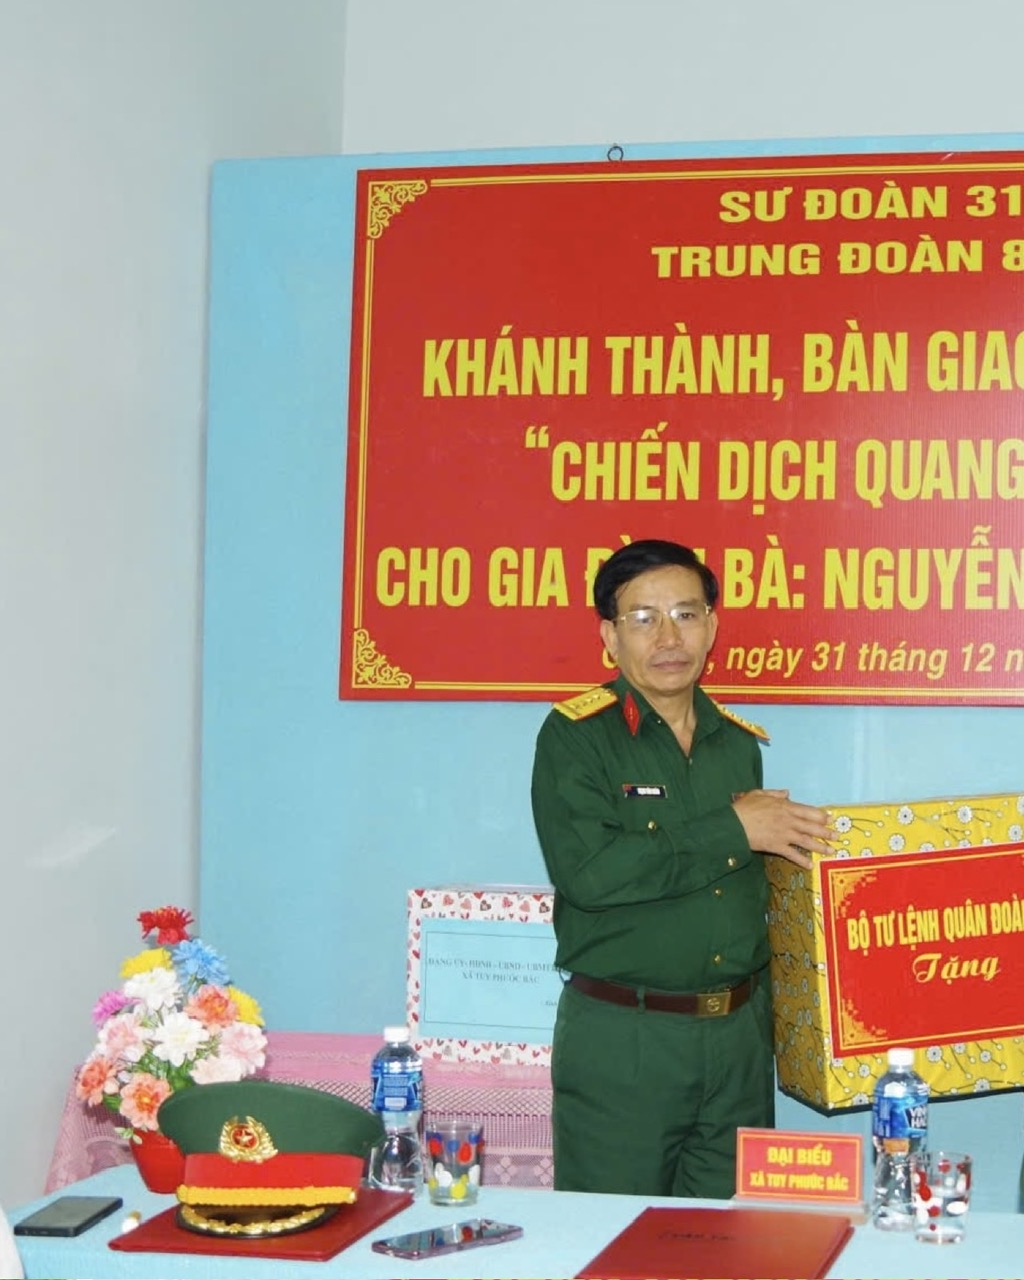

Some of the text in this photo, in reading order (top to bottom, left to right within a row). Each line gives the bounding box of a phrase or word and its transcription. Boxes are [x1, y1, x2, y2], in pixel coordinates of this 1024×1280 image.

[719, 179, 1022, 222] SƯ ĐOÀN 31
[652, 243, 820, 278] TRUNG
[839, 234, 983, 274] ĐOÀN
[422, 325, 588, 398] KHÁNH
[605, 322, 784, 402] THÀNH,
[802, 319, 908, 394] BÀN
[718, 440, 836, 515] DỊCH
[376, 546, 471, 606] CHO
[488, 547, 569, 607] GIA
[725, 534, 806, 609] BÀ:
[726, 640, 802, 678] ngày
[811, 642, 844, 671] 31
[858, 641, 947, 680] tháng
[961, 643, 993, 672] 12
[847, 910, 871, 956] BỘ
[873, 911, 896, 948] TƯ
[899, 904, 941, 952] LỆNH
[943, 898, 988, 943] QUÂN
[912, 952, 1002, 985] Tặng
